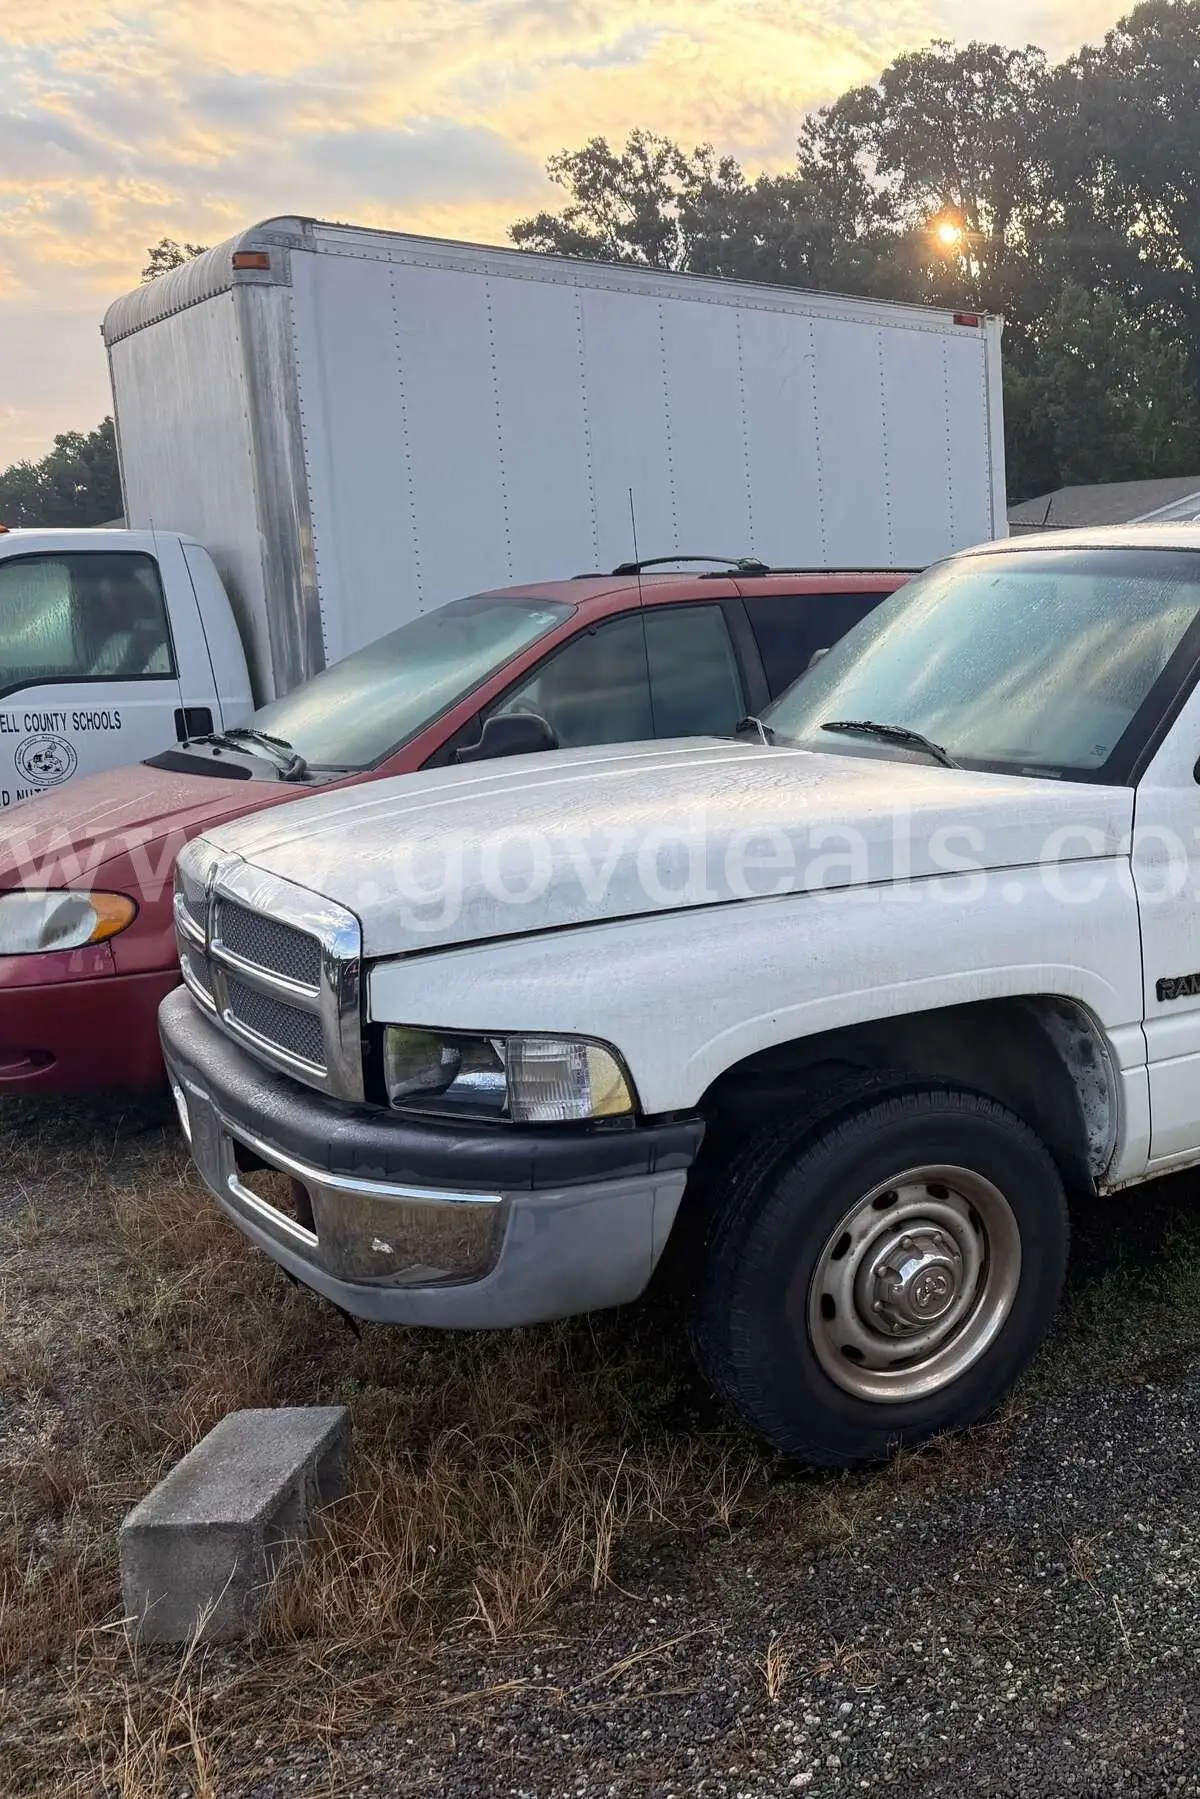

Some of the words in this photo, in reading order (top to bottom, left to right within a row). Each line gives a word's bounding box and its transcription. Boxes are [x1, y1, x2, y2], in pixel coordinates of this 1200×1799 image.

[24, 712, 67, 732] COUNTY
[72, 711, 122, 731] SCHOOLS
[0, 790, 11, 807] D
